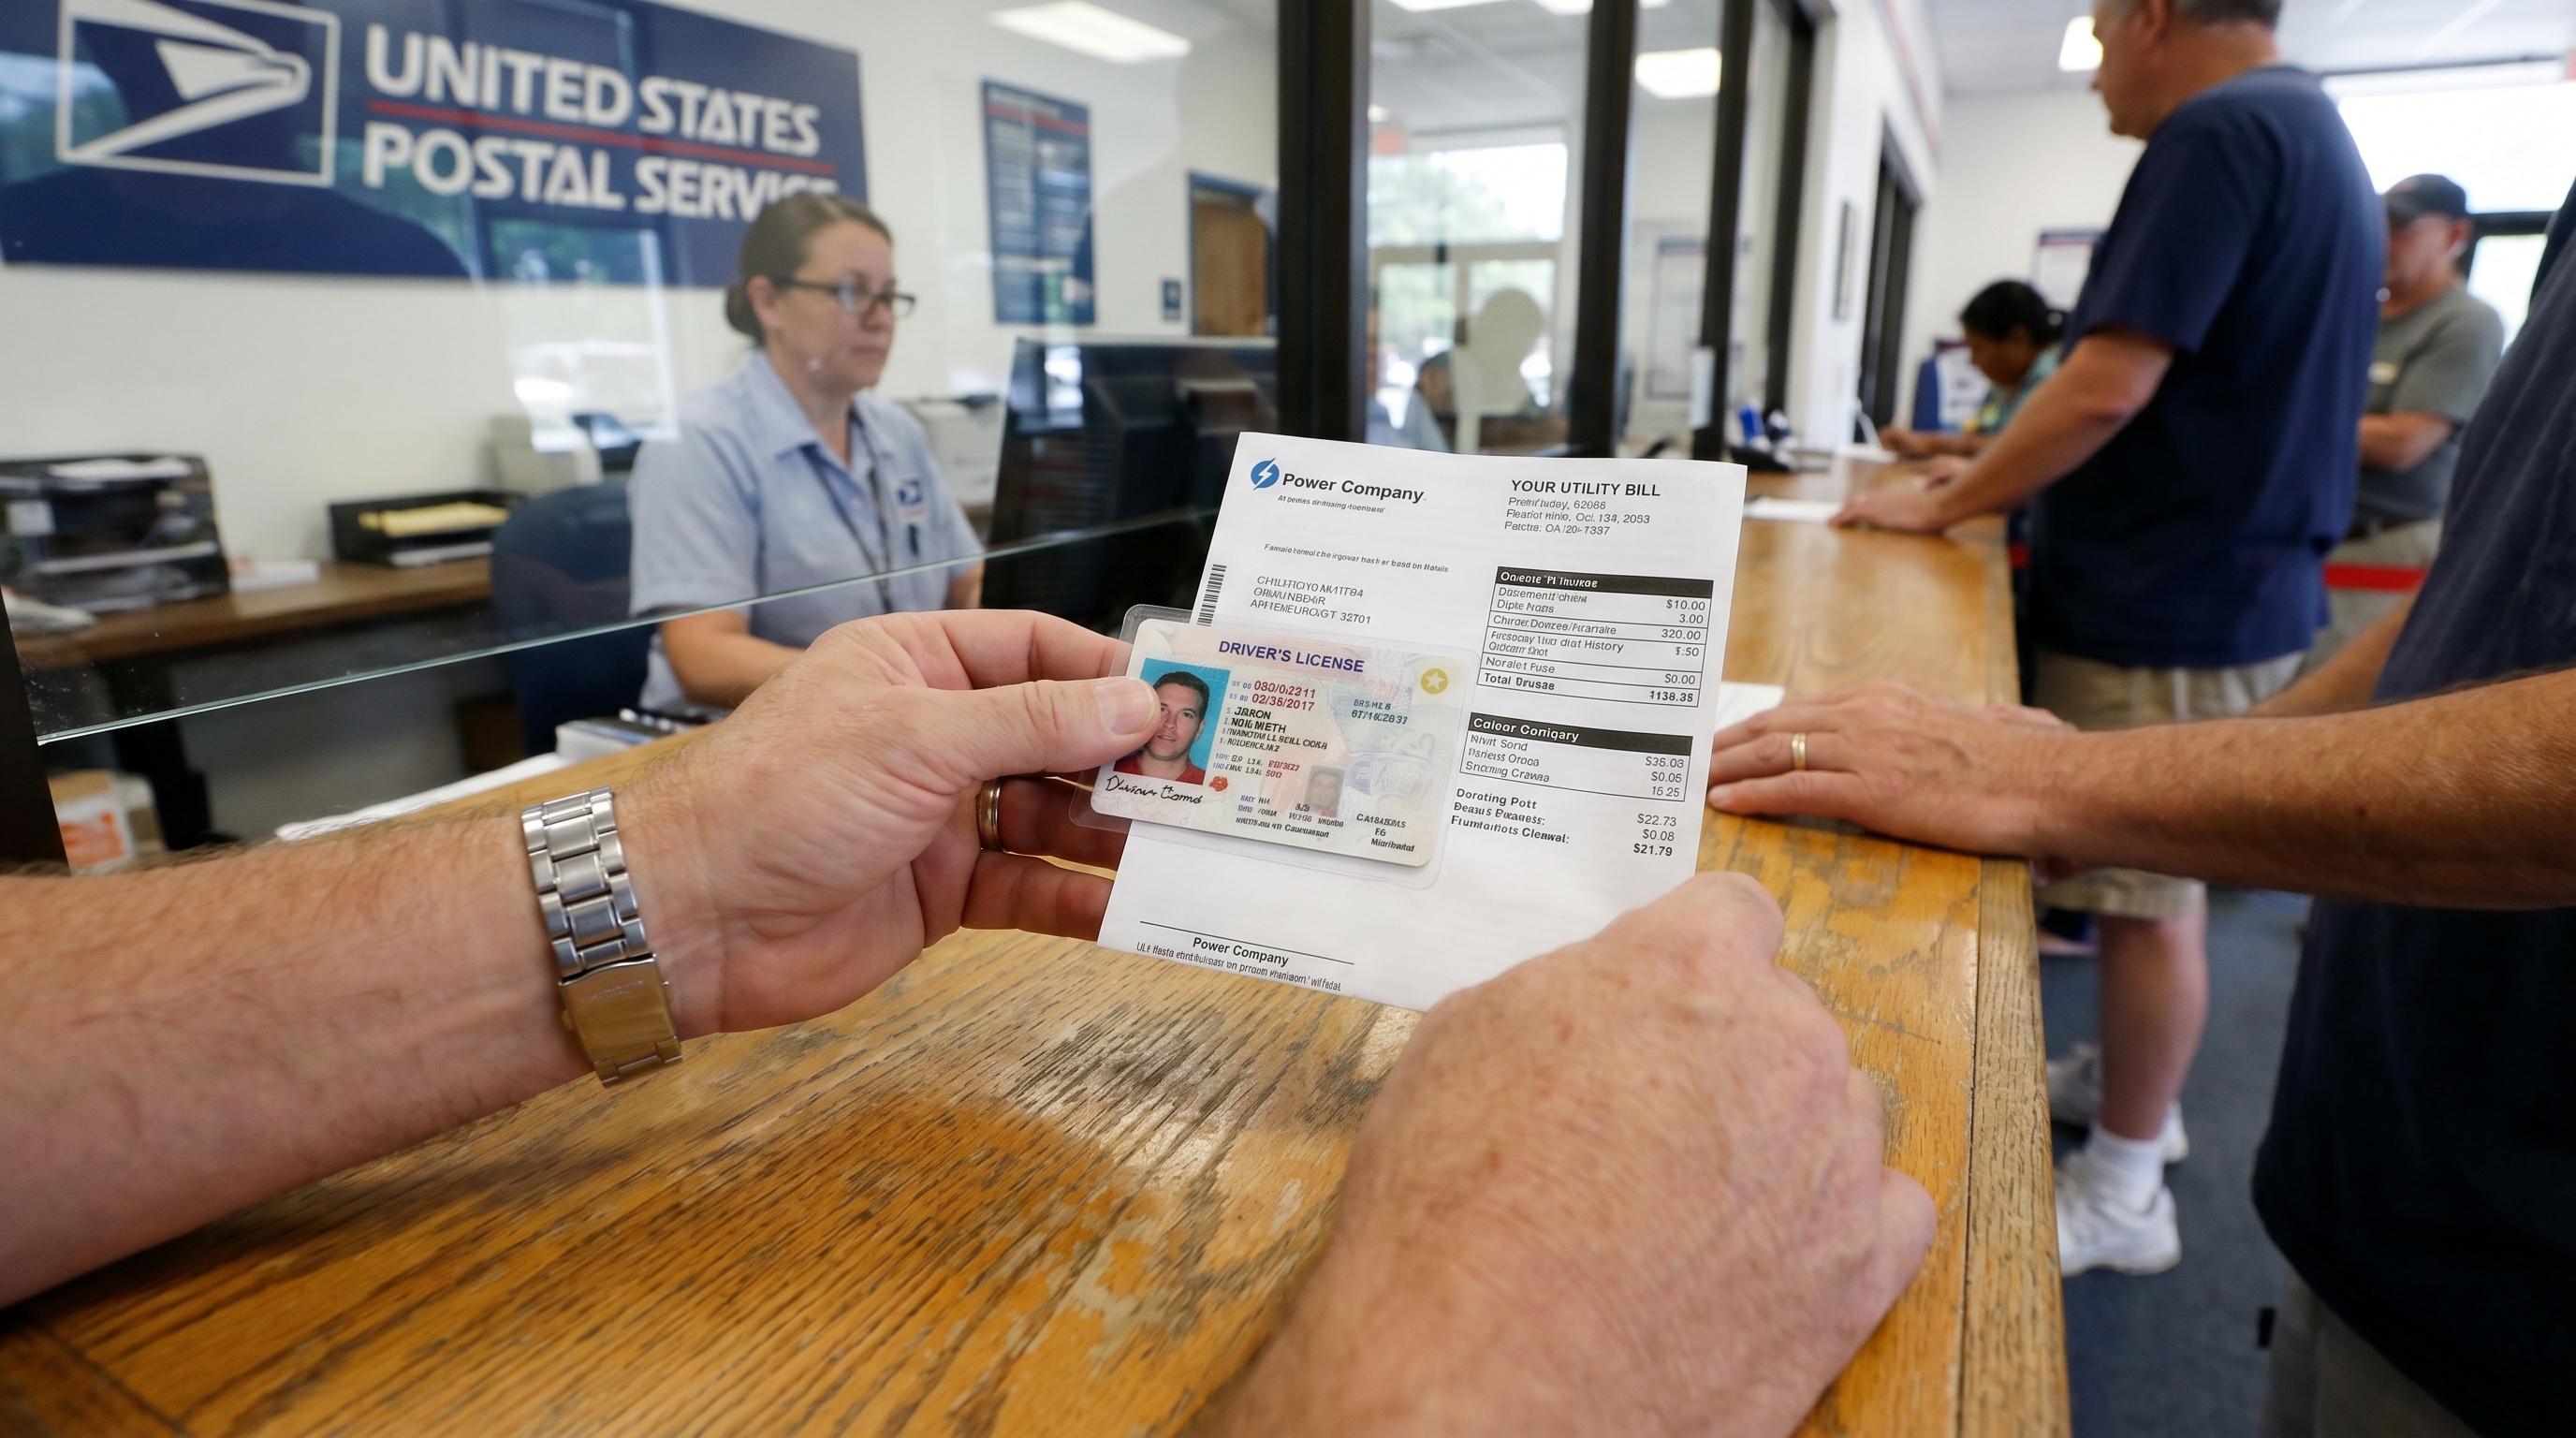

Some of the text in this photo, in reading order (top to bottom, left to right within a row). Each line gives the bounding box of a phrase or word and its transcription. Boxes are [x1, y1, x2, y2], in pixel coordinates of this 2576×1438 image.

[365, 22, 821, 157] UNITED STATES
[362, 121, 839, 223] POSTAL SERVI
[1282, 473, 1426, 504] Power Company
[1511, 479, 1661, 496] YOUR UTILITY BILL
[1666, 599, 1705, 611] $10.00
[1678, 613, 1704, 624] 3.00
[1661, 629, 1701, 640] 320.00
[1585, 640, 1625, 654] History
[1218, 640, 1365, 673] DRIVER'S LICENSE
[1485, 672, 1511, 686] Total
[1510, 796, 1538, 810] Pott
[1637, 813, 1676, 828] $22.73
[1642, 829, 1675, 842] $0.08
[1633, 843, 1673, 858] $21.79
[1193, 936, 1290, 968] Power Company
